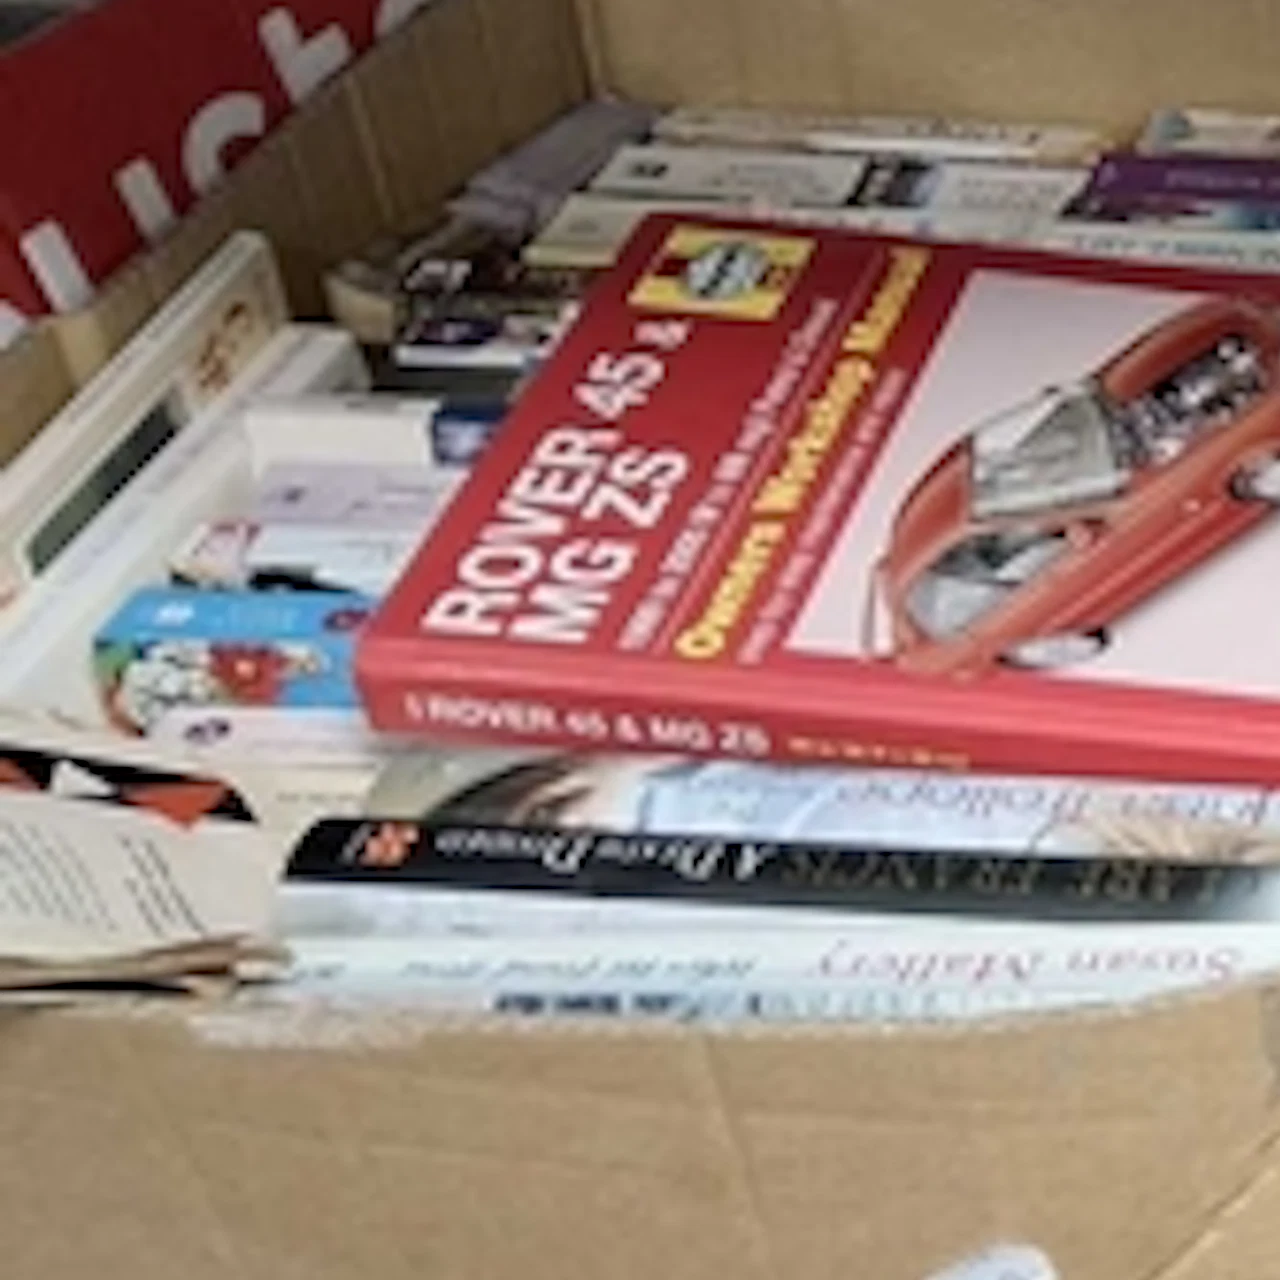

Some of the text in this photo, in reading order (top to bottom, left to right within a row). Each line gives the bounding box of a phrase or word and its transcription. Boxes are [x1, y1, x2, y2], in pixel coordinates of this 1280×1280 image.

[420, 426, 625, 637] ROVER
[573, 351, 666, 419] 45
[507, 537, 638, 643] MG
[579, 447, 690, 530] ZS
[674, 521, 786, 659] Owners
[751, 355, 878, 513] Workshop
[841, 244, 933, 352] Manual
[429, 696, 556, 735] ROVER
[812, 939, 1241, 984] Susan Mallery
